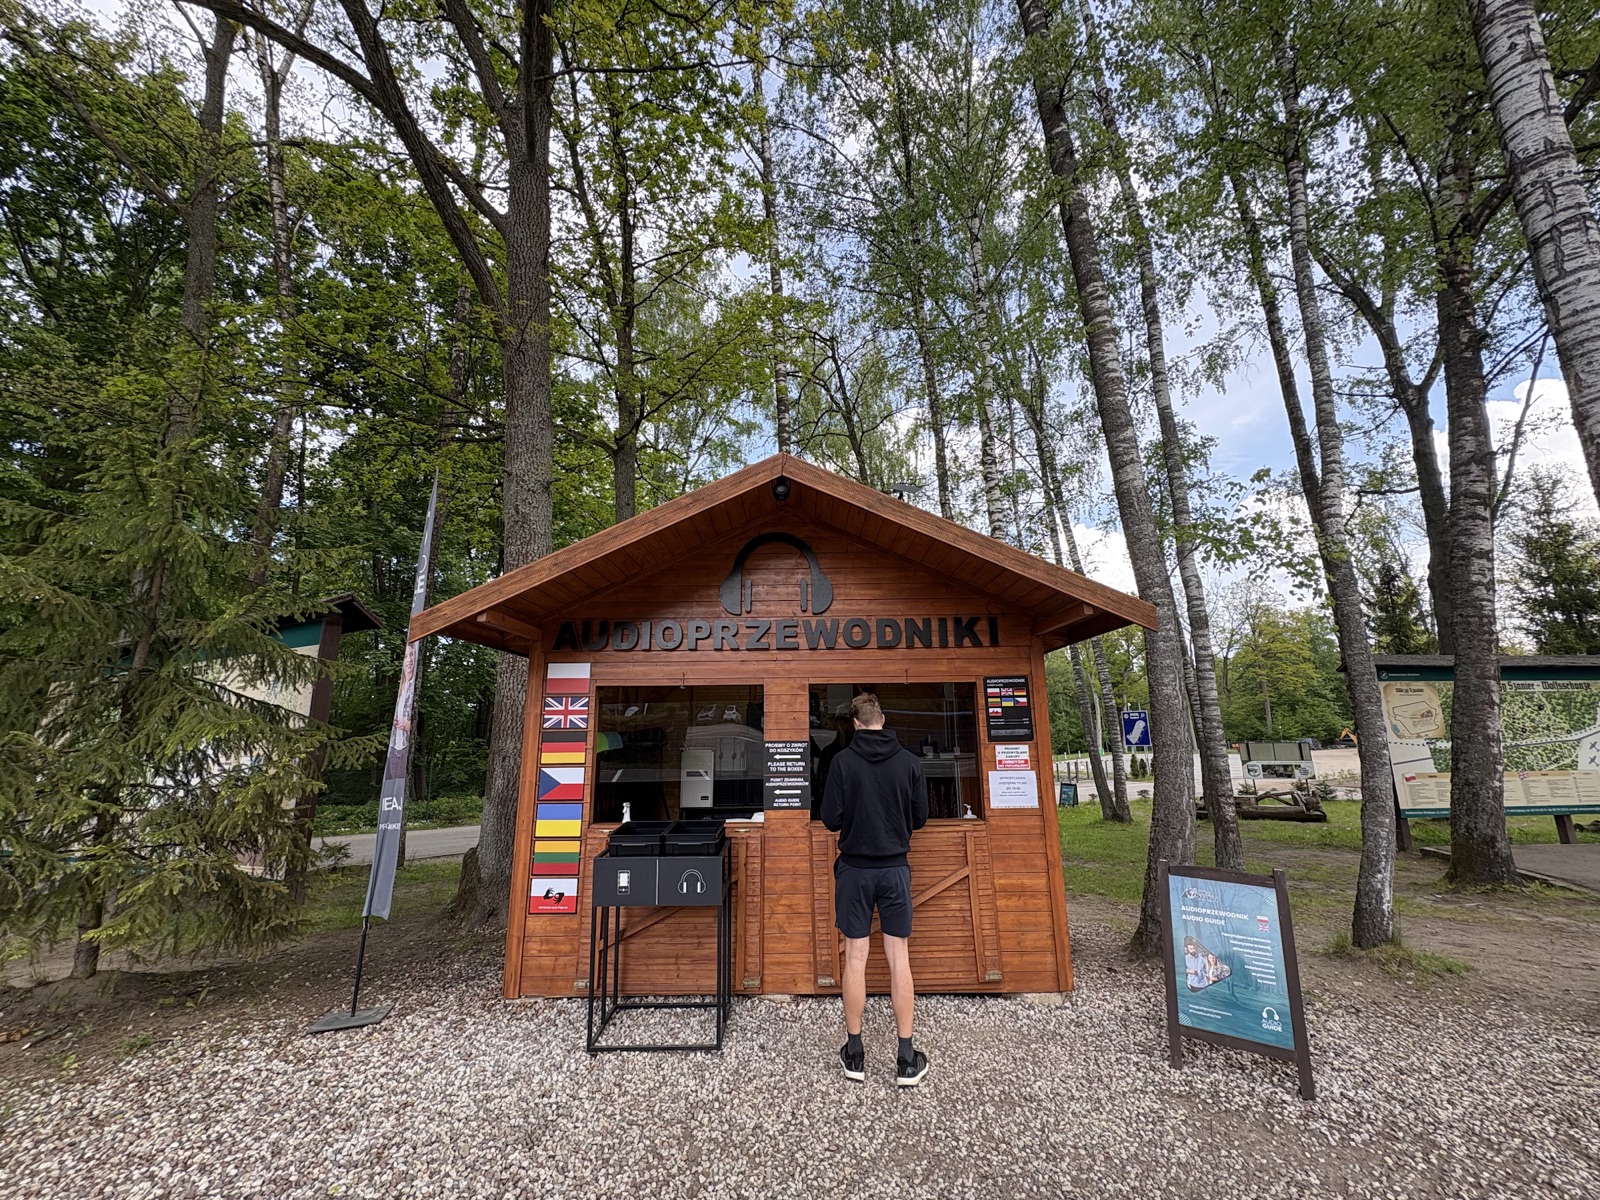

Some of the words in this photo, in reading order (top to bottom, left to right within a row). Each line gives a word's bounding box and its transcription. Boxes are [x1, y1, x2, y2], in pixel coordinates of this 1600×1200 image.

[552, 616, 999, 651] AUDIOPRZEWODNIKI
[1181, 906, 1249, 920] AUDIOPRZEWODNIK
[1204, 917, 1225, 926] GUIDE
[1262, 1023, 1282, 1032] GUIDE
